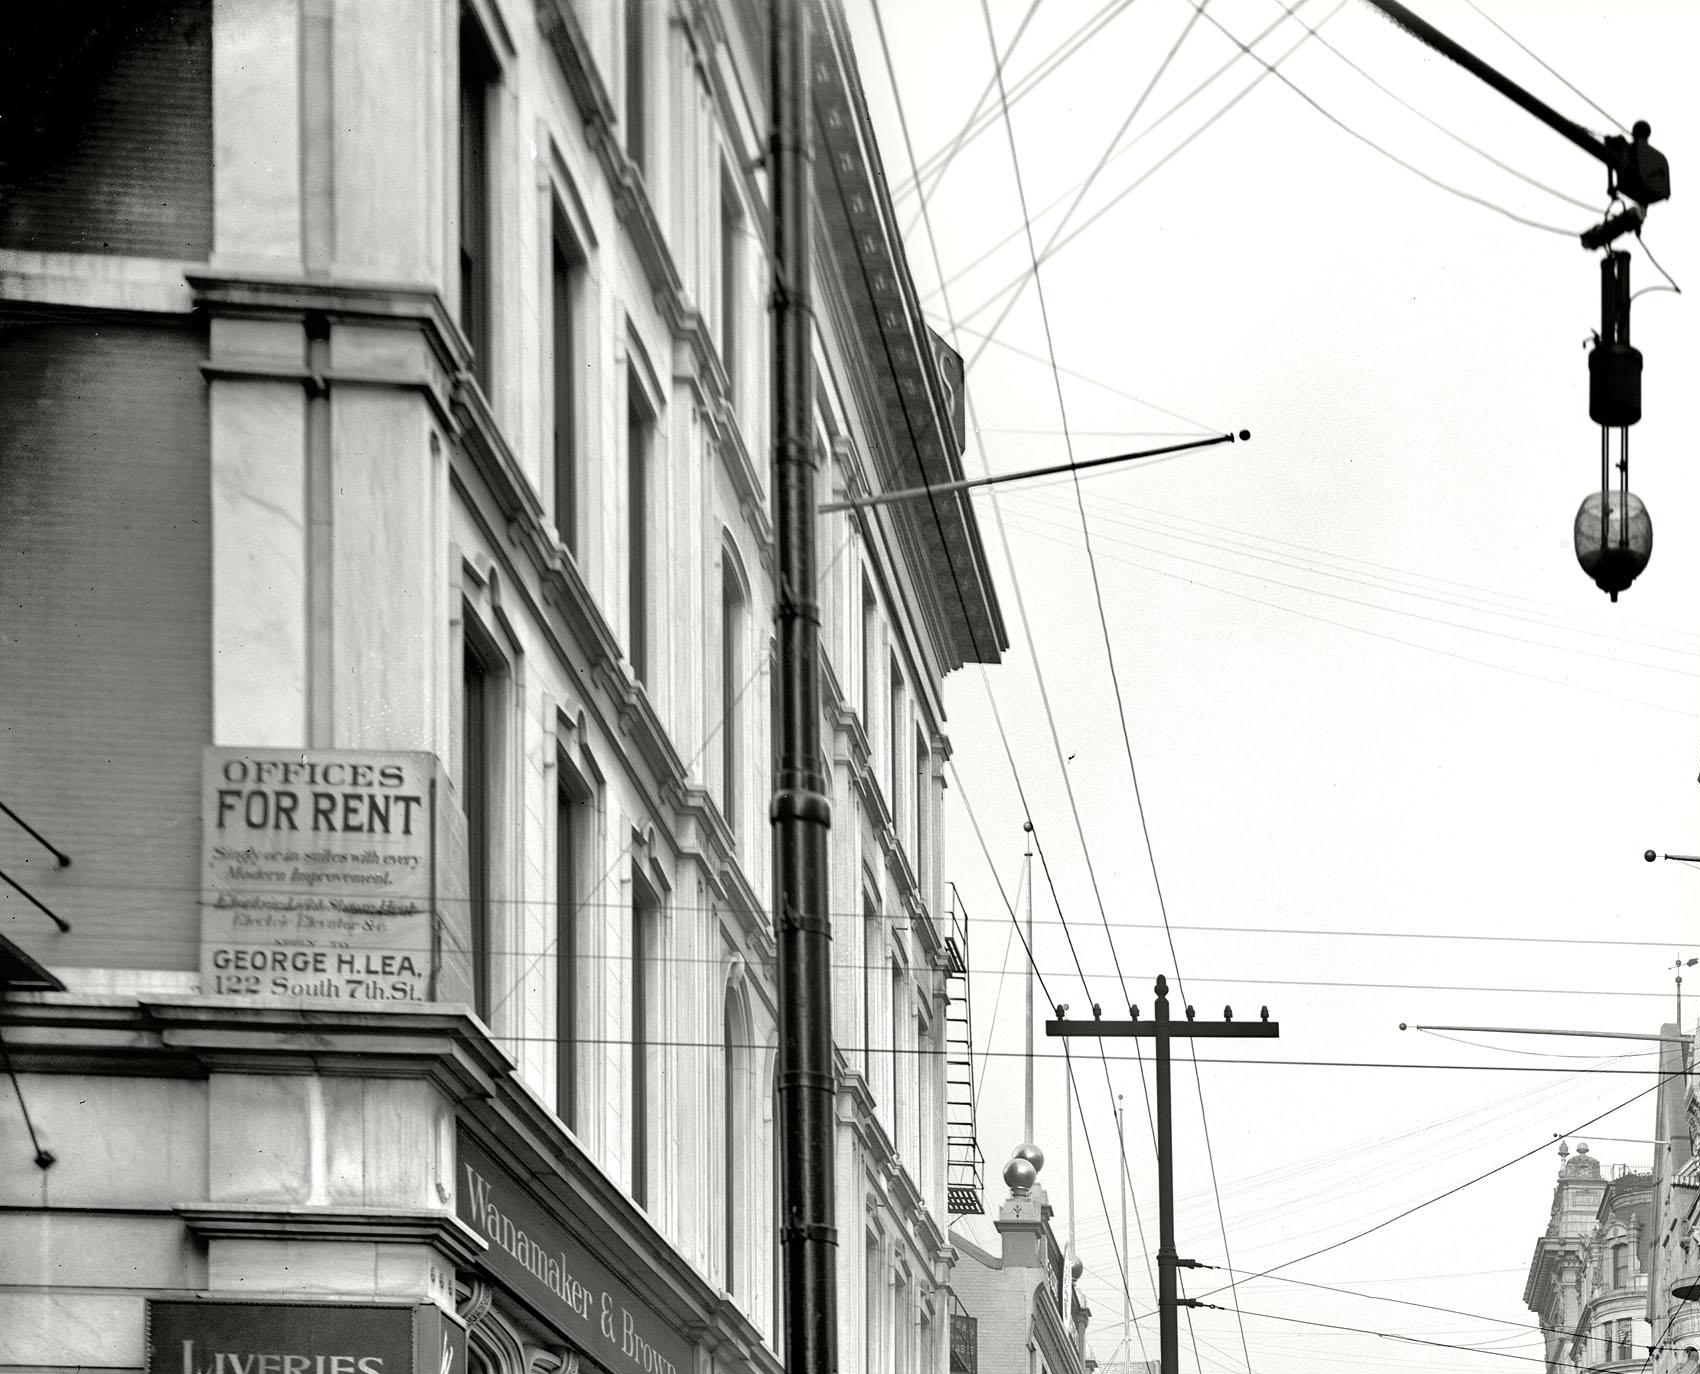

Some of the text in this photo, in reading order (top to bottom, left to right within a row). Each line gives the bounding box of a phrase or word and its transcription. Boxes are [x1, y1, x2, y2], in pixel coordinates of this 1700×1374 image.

[223, 759, 404, 788] OFFICES
[216, 789, 422, 835] FOR RENT
[213, 949, 328, 973] GEORGE
[214, 974, 261, 995] 122
[271, 975, 340, 999] South
[463, 1161, 593, 1321] Wanamaker
[601, 1291, 616, 1343] &
